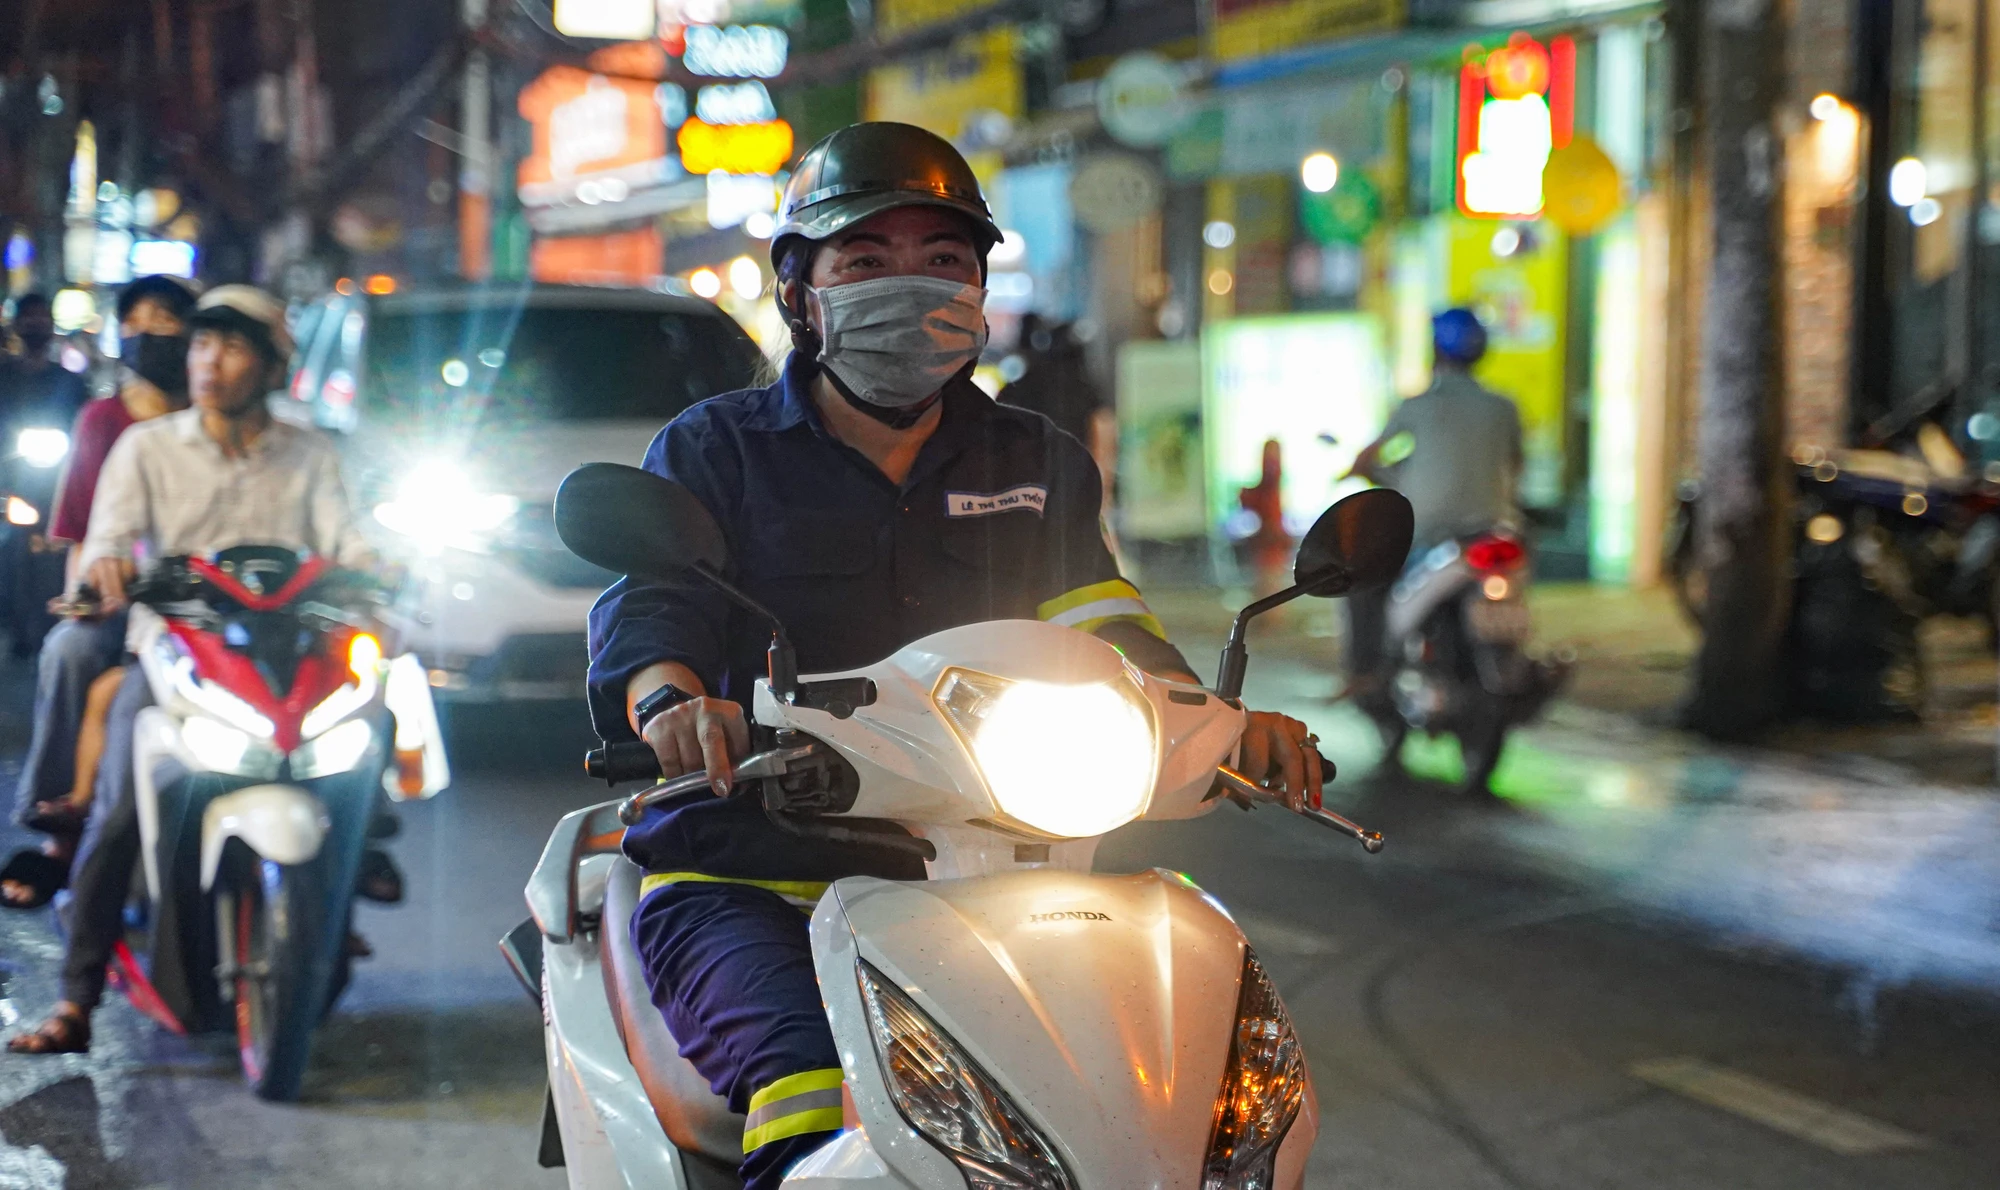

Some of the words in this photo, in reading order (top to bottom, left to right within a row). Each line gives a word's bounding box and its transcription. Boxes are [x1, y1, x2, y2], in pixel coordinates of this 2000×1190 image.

[961, 500, 974, 511] LÊ
[998, 496, 1019, 507] THU
[1029, 911, 1113, 923] HONDA
